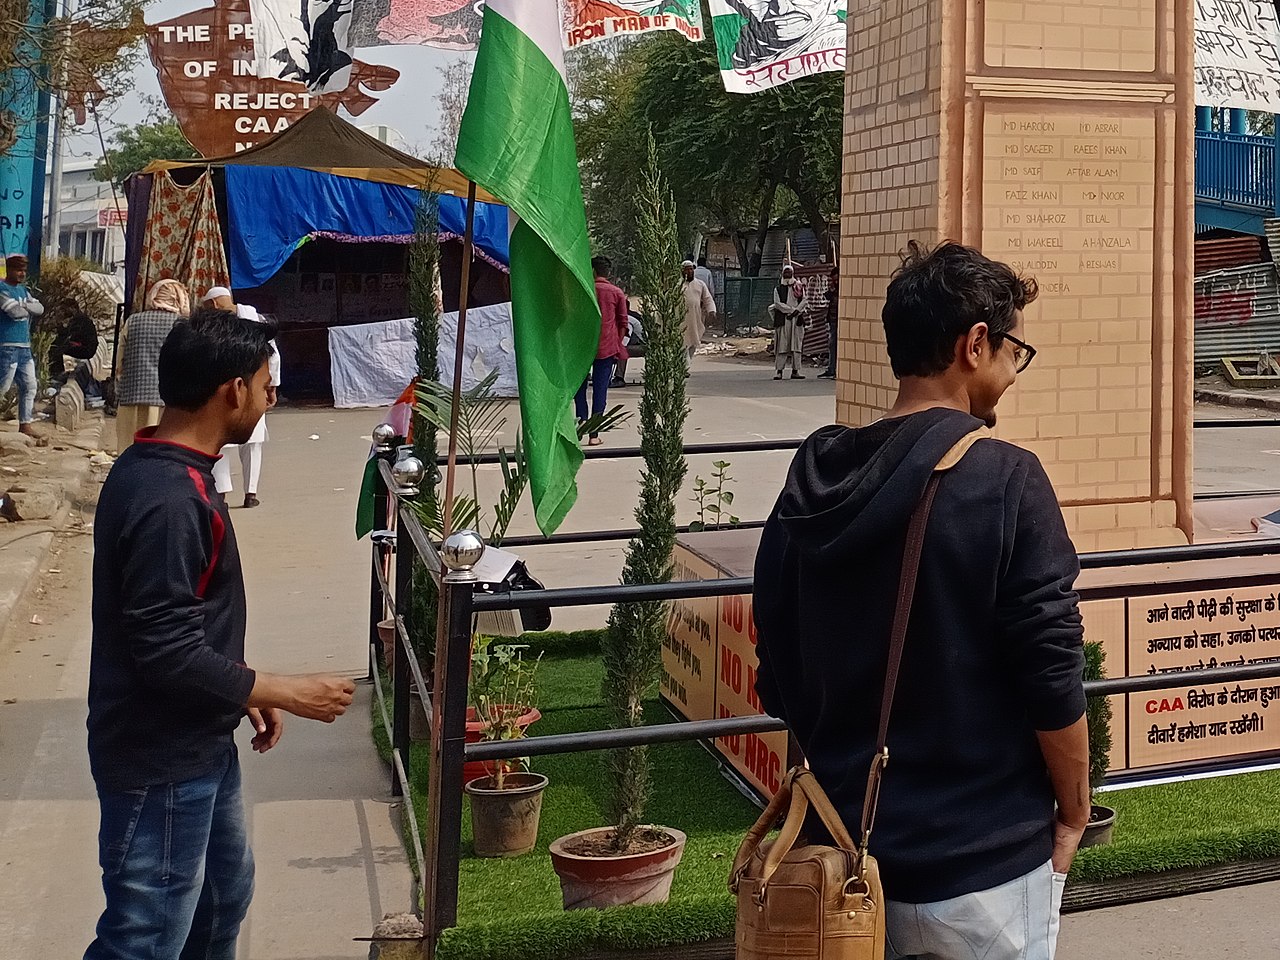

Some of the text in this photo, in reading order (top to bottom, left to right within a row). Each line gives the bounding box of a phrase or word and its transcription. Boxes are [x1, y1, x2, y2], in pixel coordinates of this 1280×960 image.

[158, 25, 211, 43] THE
[568, 22, 606, 47] IRON
[613, 16, 650, 32] MAN
[654, 15, 671, 27] OF
[183, 61, 218, 78] OF
[215, 93, 313, 110] REJECT
[235, 117, 290, 134] CAA
[1003, 121, 1055, 132] MD HAROON
[1005, 144, 1019, 154] MD
[1073, 145, 1128, 155] RAEES KHAN
[1004, 167, 1018, 176] MD
[1066, 168, 1119, 178] AFTAB ALAM
[1005, 190, 1058, 200] FAIZ KHAN
[1082, 191, 1125, 201] MD NOOR
[1006, 214, 1067, 224] MD SHAHROZ
[1085, 214, 1111, 224] BILAL
[1008, 237, 1064, 248] MD WAKEEL
[1147, 602, 1169, 623] आने
[1171, 599, 1195, 621] वाली
[1197, 597, 1218, 622] पीढ़ी
[1219, 595, 1234, 616] की
[1236, 598, 1263, 622] सुरक्षा
[1264, 593, 1276, 612] के
[1147, 637, 1182, 654] अन्याय
[1183, 629, 1199, 650] को
[1200, 632, 1224, 648] सहा,
[1226, 624, 1256, 646] उनको
[720, 644, 742, 695] NO
[1145, 697, 1185, 714] CAA
[1187, 689, 1215, 710] विरोध
[1216, 686, 1229, 706] के
[1230, 684, 1259, 705] दौरान
[1147, 720, 1228, 744] दीवारें हमेशा याद
[744, 733, 781, 796] NRC
